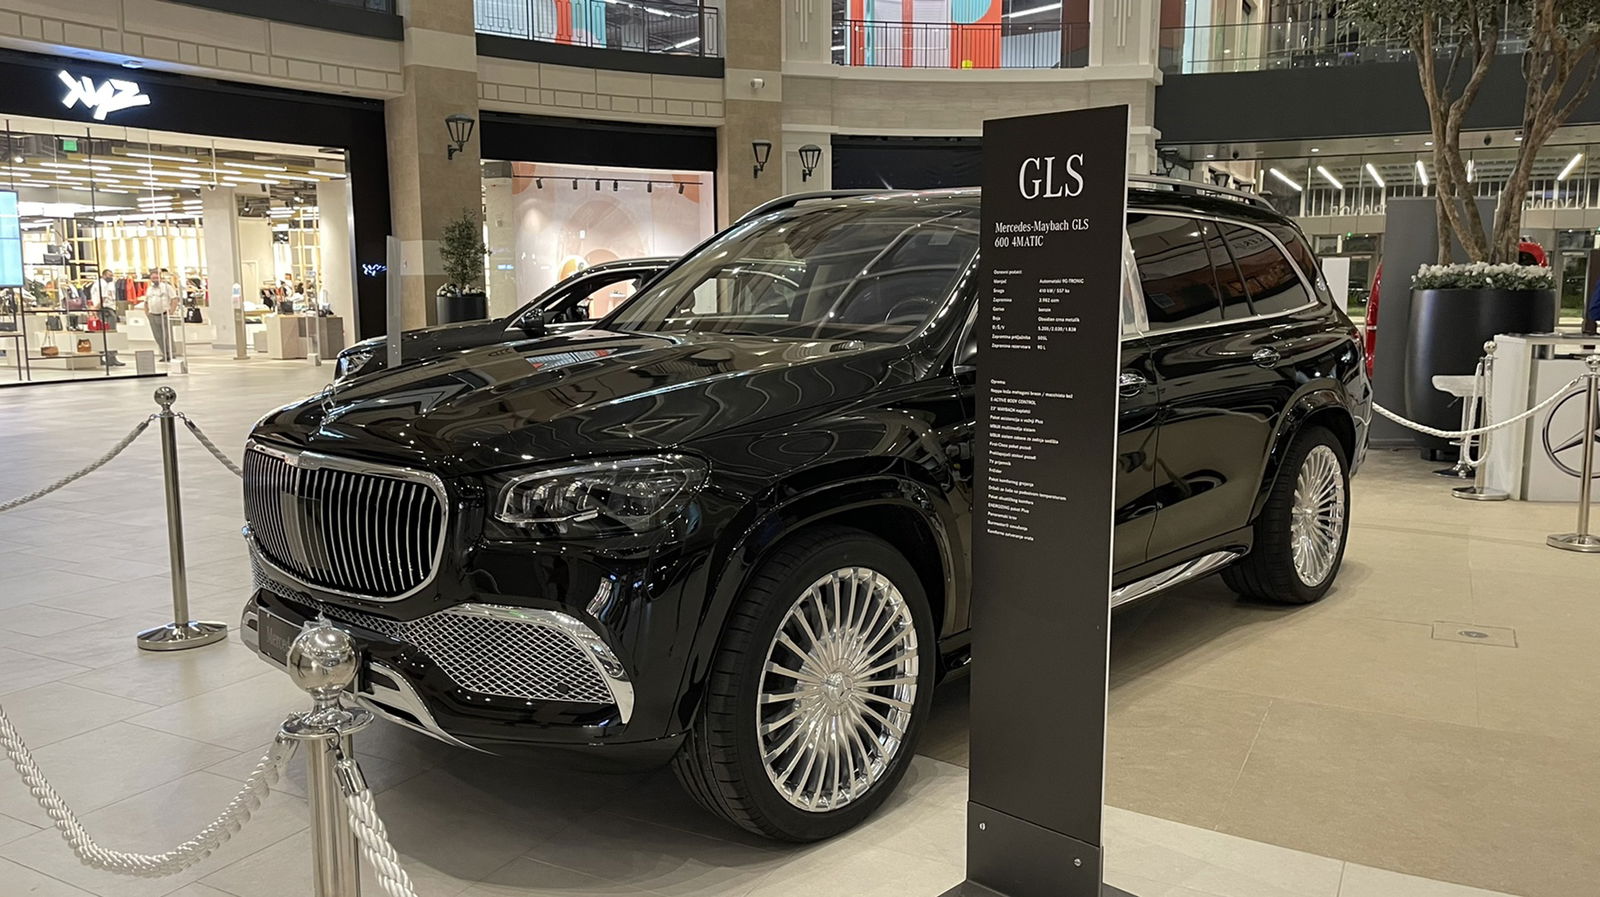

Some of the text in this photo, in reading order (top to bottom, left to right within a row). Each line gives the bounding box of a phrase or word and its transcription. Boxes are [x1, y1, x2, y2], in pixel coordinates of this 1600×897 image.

[1018, 153, 1084, 200] GLS
[995, 218, 1090, 234] Mercedes-Maybach GLS
[994, 235, 1044, 248] 600 4MATIC
